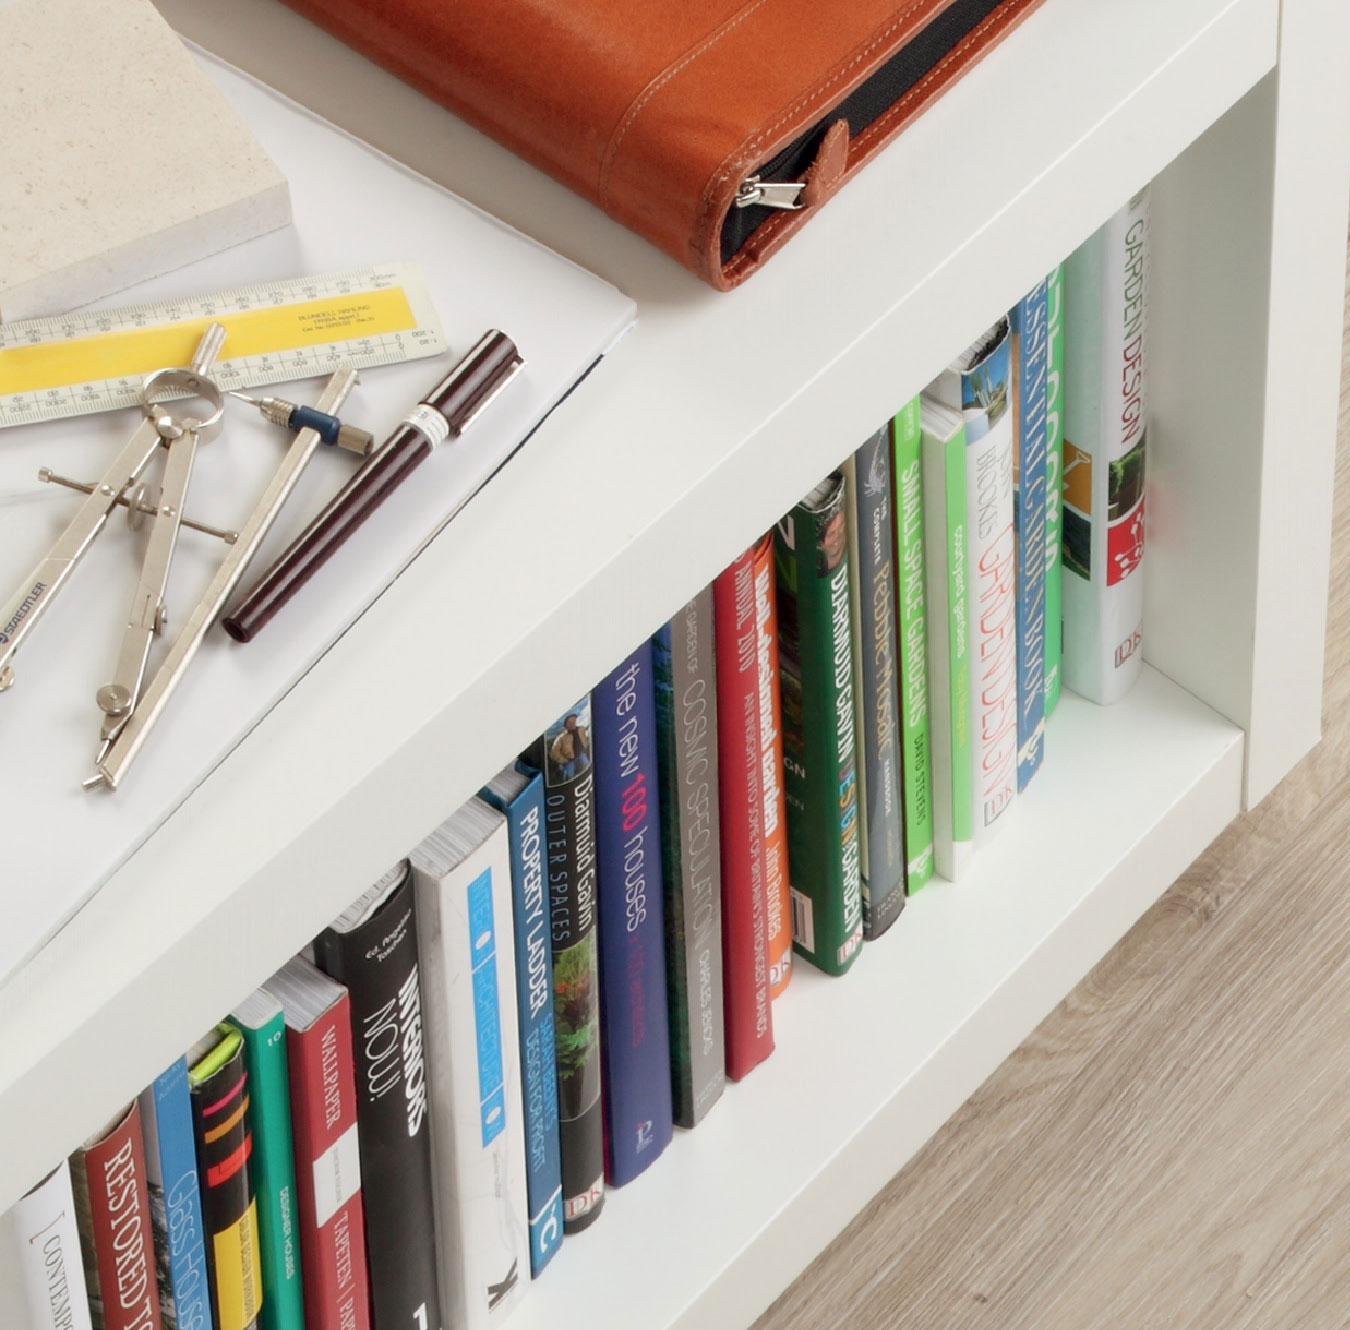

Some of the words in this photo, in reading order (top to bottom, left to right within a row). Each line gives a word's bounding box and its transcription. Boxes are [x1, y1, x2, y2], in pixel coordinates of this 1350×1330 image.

[1124, 218, 1144, 341] GARDEN
[1121, 334, 1143, 445] DESIGN
[902, 458, 921, 547] SMALL
[976, 445, 998, 541] BROOKES
[873, 507, 882, 566] COMPLETE
[952, 523, 964, 599] courtyard
[1024, 474, 1046, 627] GARDEN
[3, 582, 48, 635] STAEDTLER
[735, 560, 754, 631] ANNUAL
[873, 559, 892, 665] Pebble
[904, 538, 925, 621] SPACE
[979, 522, 1016, 681] GARDEN
[737, 623, 756, 674] 2010
[830, 562, 852, 690] DIARMUID
[953, 596, 966, 659] gardens
[1024, 613, 1044, 718] BOOK
[615, 662, 640, 717] the
[876, 655, 896, 761] Mosaic
[907, 615, 927, 728] GARDENS
[618, 715, 639, 778] new
[682, 679, 708, 785] COSMIC
[745, 712, 758, 768] INSIGHT
[836, 683, 854, 764] GAVIN
[912, 733, 925, 770] DAVID
[980, 655, 1016, 797] DESIGN
[574, 773, 595, 874] Diarmuid
[621, 772, 648, 833] 100
[747, 766, 759, 803] INTO
[748, 800, 760, 842] SOME
[838, 754, 857, 847] DESIGN
[915, 768, 929, 827] STEVENS
[520, 805, 543, 926] PROPERTY
[547, 794, 568, 864] OUTER
[687, 783, 713, 951] SPECULATION
[550, 871, 571, 943] SPACES
[578, 868, 596, 933] Gavin
[624, 825, 648, 933] houses
[766, 873, 784, 943] Brookes
[841, 841, 861, 934] GARDEN
[365, 945, 381, 959] Ed.
[526, 919, 549, 1021] LADDER
[362, 998, 401, 1102] NOW!
[398, 963, 428, 1138] INTERIORS
[756, 985, 768, 1040] BRANDS
[526, 1027, 541, 1091] DESIGN
[321, 1024, 342, 1131] WALLPAPER
[334, 1210, 352, 1290] TAPETEN
[104, 1137, 153, 1310] RESTORED
[168, 1169, 198, 1257] Glass
[280, 1184, 293, 1238] DESIGNER
[284, 1234, 296, 1280] HOUSES
